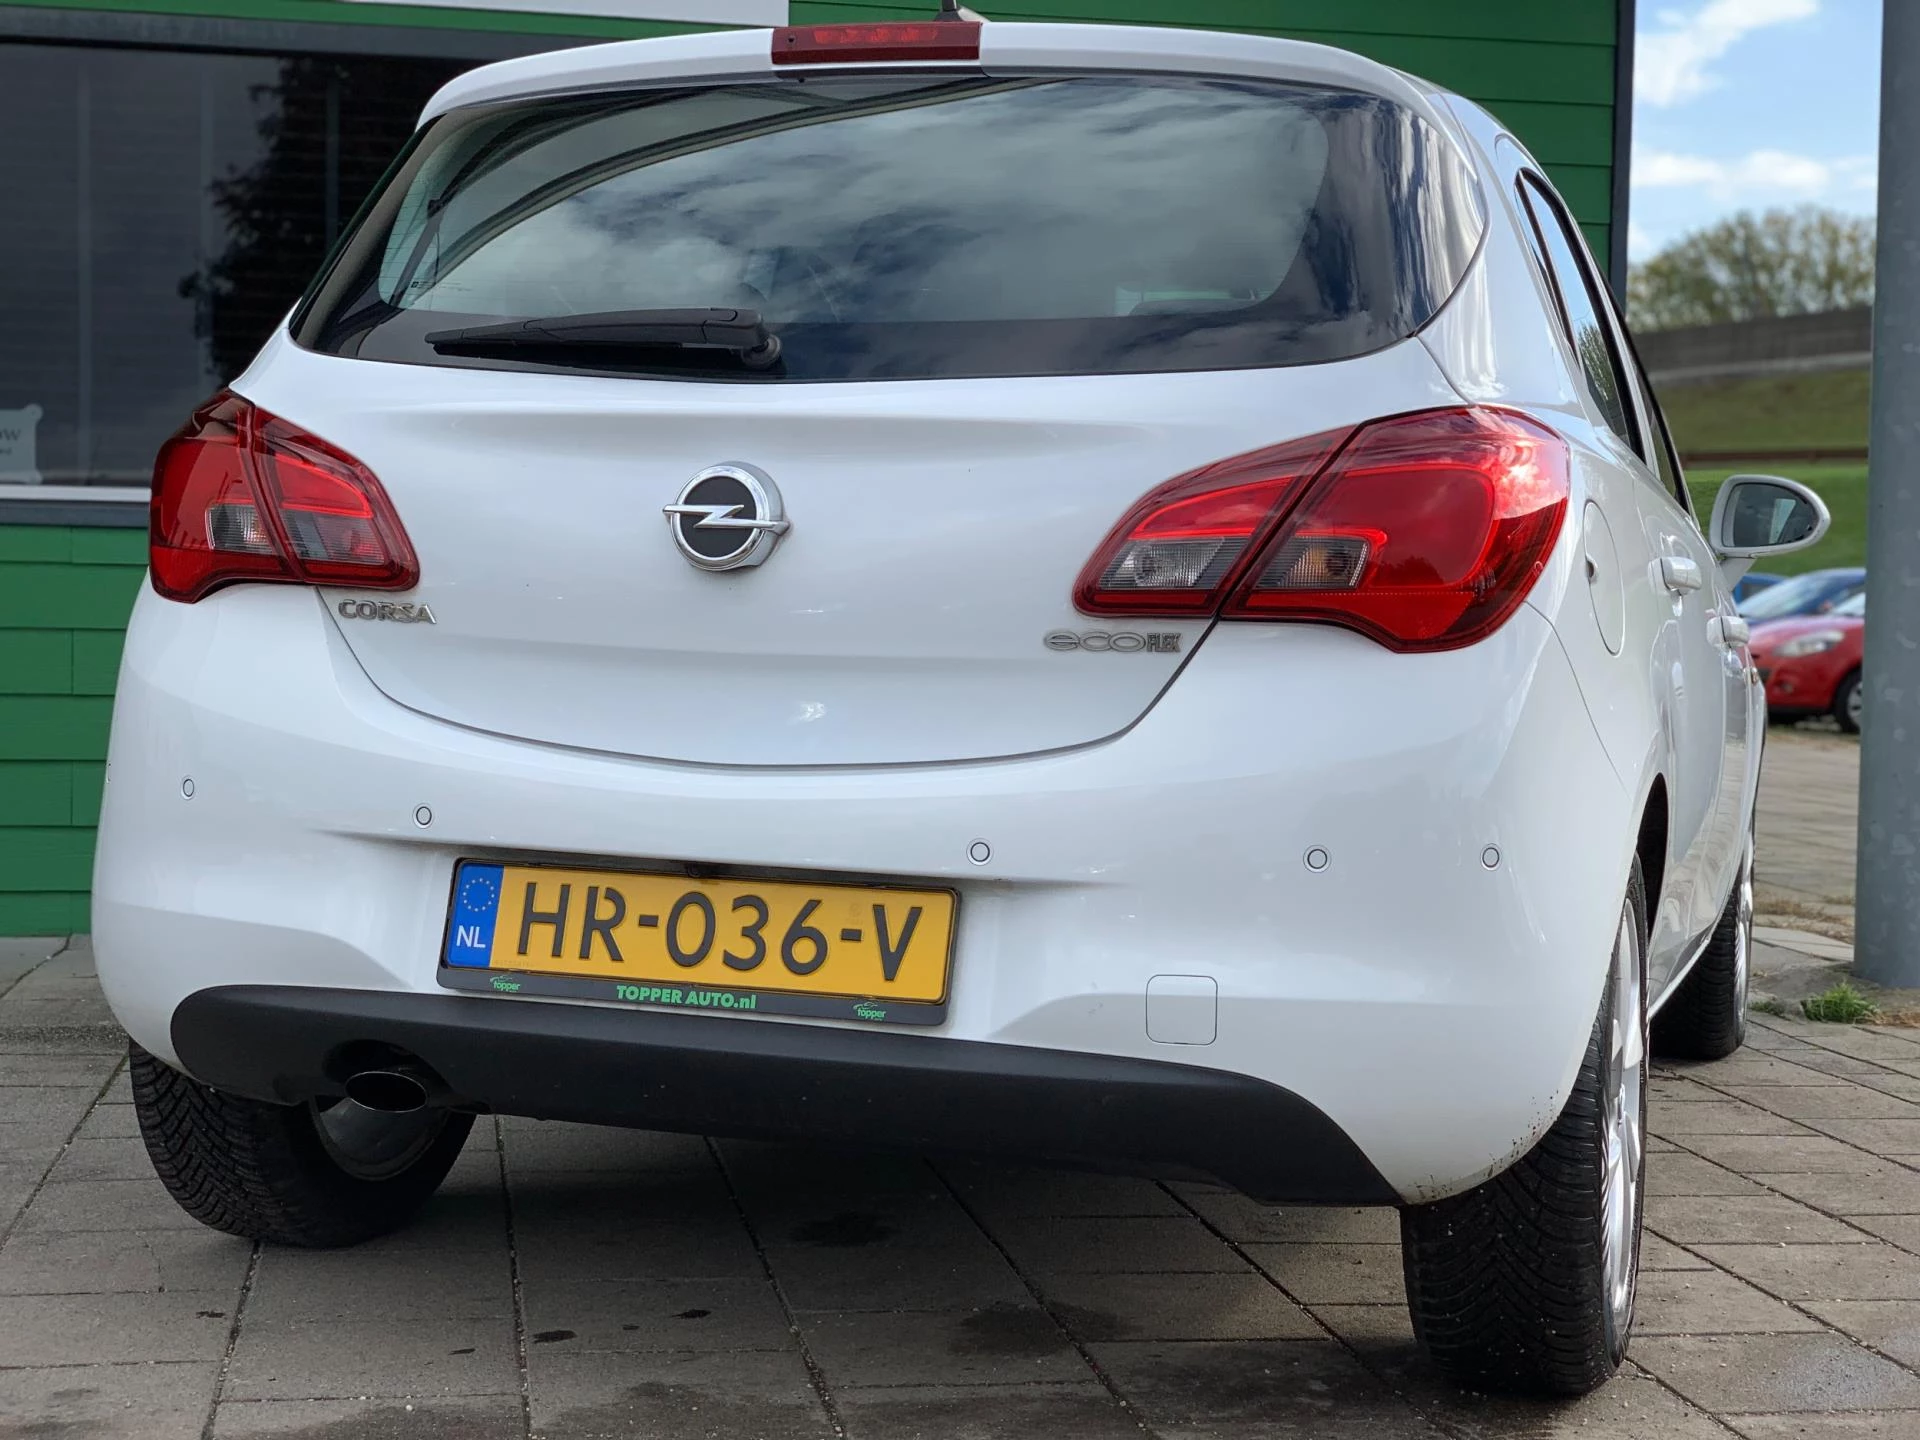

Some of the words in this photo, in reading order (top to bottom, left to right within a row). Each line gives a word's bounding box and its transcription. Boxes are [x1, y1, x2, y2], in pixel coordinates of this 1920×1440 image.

[338, 599, 436, 624] CORSA
[456, 925, 486, 949] NL
[517, 881, 923, 982] HR-036-V
[616, 985, 683, 1004] TOPPER
[685, 990, 757, 1009] AUTO.nl
